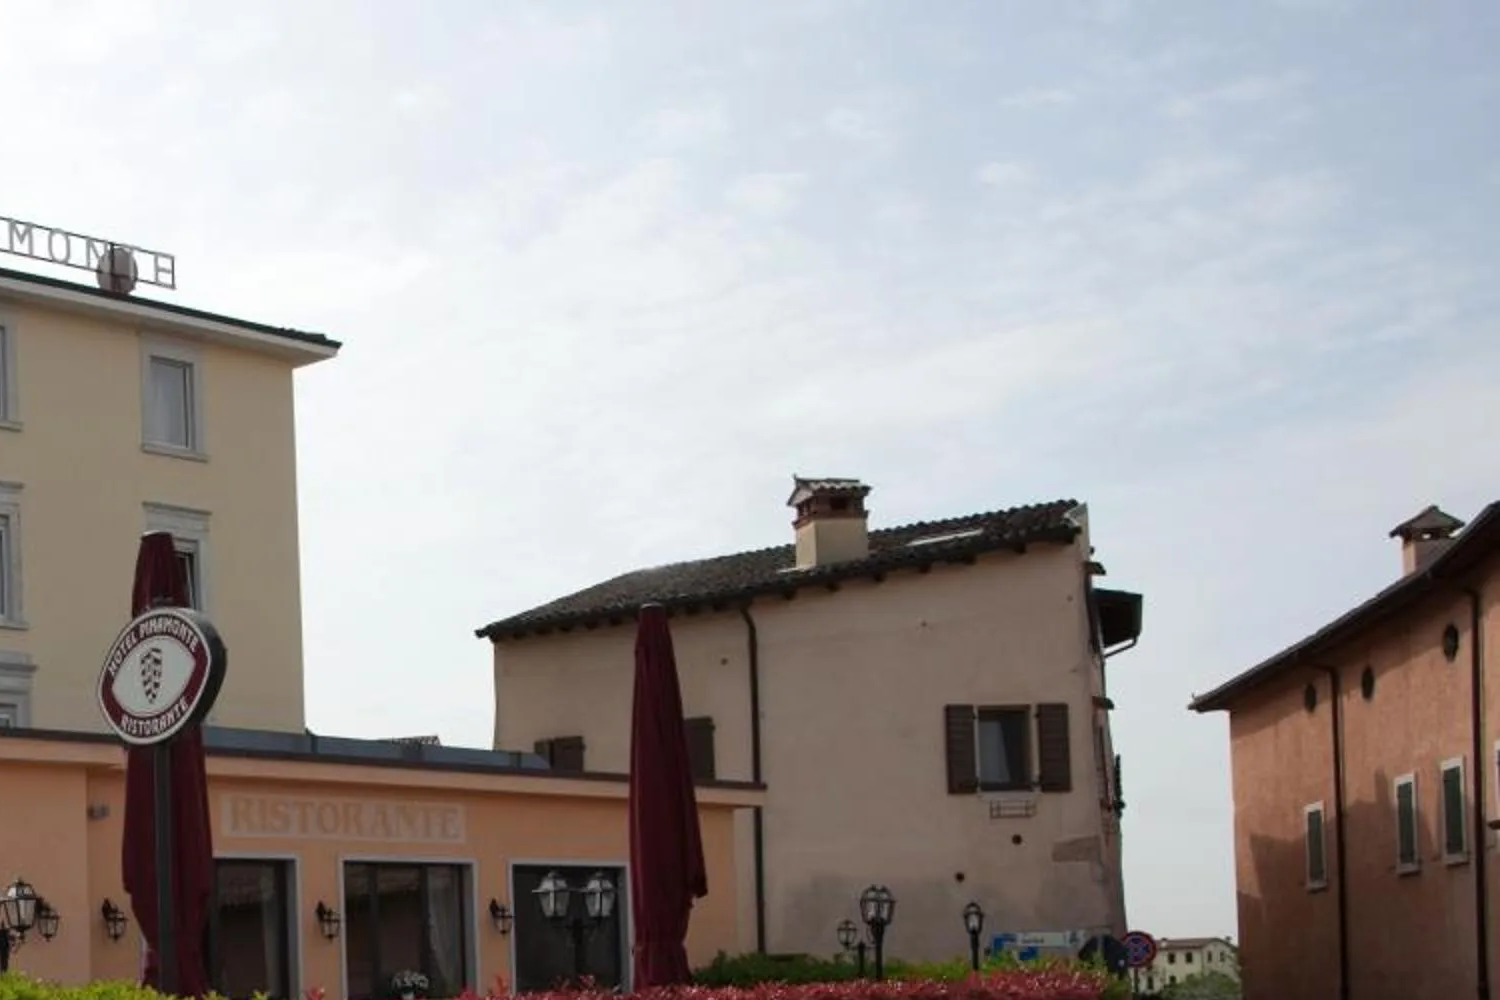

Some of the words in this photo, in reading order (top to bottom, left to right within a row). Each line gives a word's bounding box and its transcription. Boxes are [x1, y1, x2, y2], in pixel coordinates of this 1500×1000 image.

[108, 631, 138, 676] HOTEL
[140, 617, 199, 653] PINAMONTE
[120, 697, 189, 735] RISTORANTE
[231, 800, 461, 840] RISTORANTE
